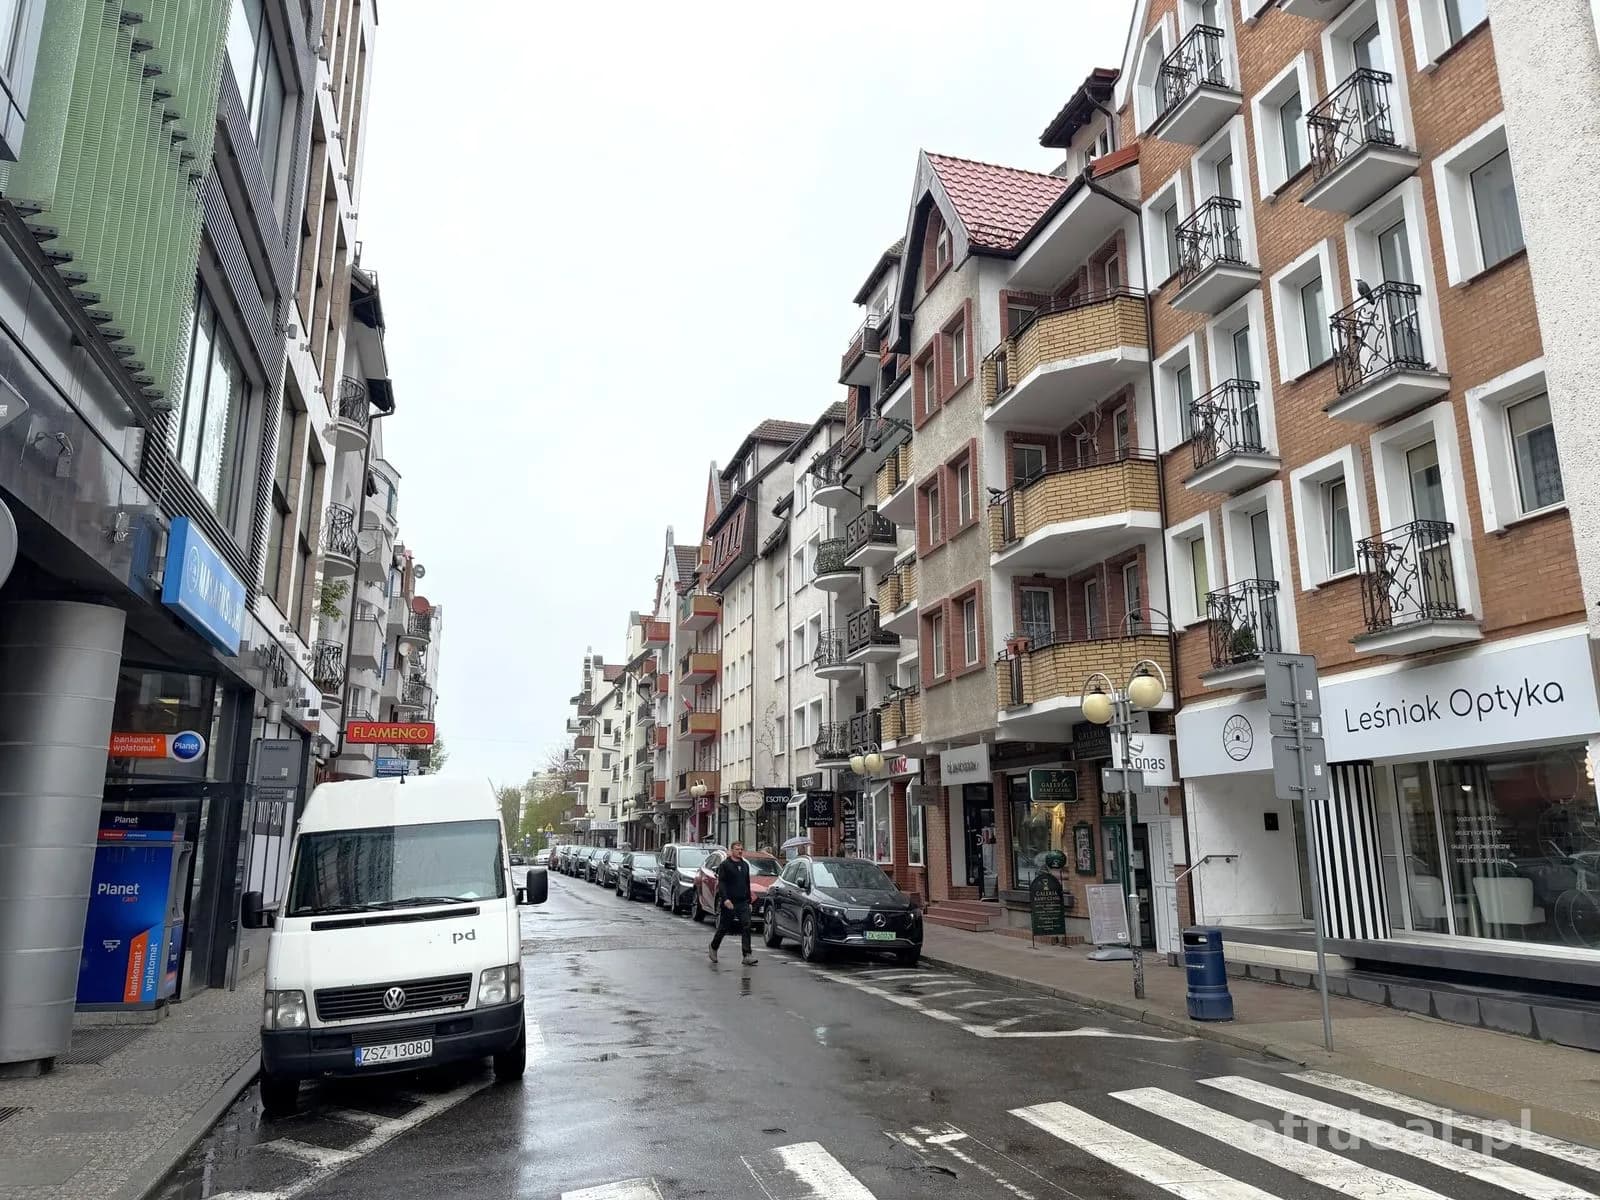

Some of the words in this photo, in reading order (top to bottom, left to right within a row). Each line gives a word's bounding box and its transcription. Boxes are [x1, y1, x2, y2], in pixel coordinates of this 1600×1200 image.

[1344, 694, 1441, 733] Leśniak
[1449, 677, 1564, 722] Optyka
[353, 726, 428, 739] FLAMENCO
[113, 735, 154, 744] bankomat
[174, 742, 199, 751] Planet
[1126, 756, 1166, 770] onas
[114, 815, 139, 825] Planet
[97, 883, 140, 895] Planet
[452, 929, 476, 944] pd
[128, 950, 142, 997] bankomat
[362, 1046, 388, 1062] ZSZ
[393, 1040, 431, 1059] 13080
